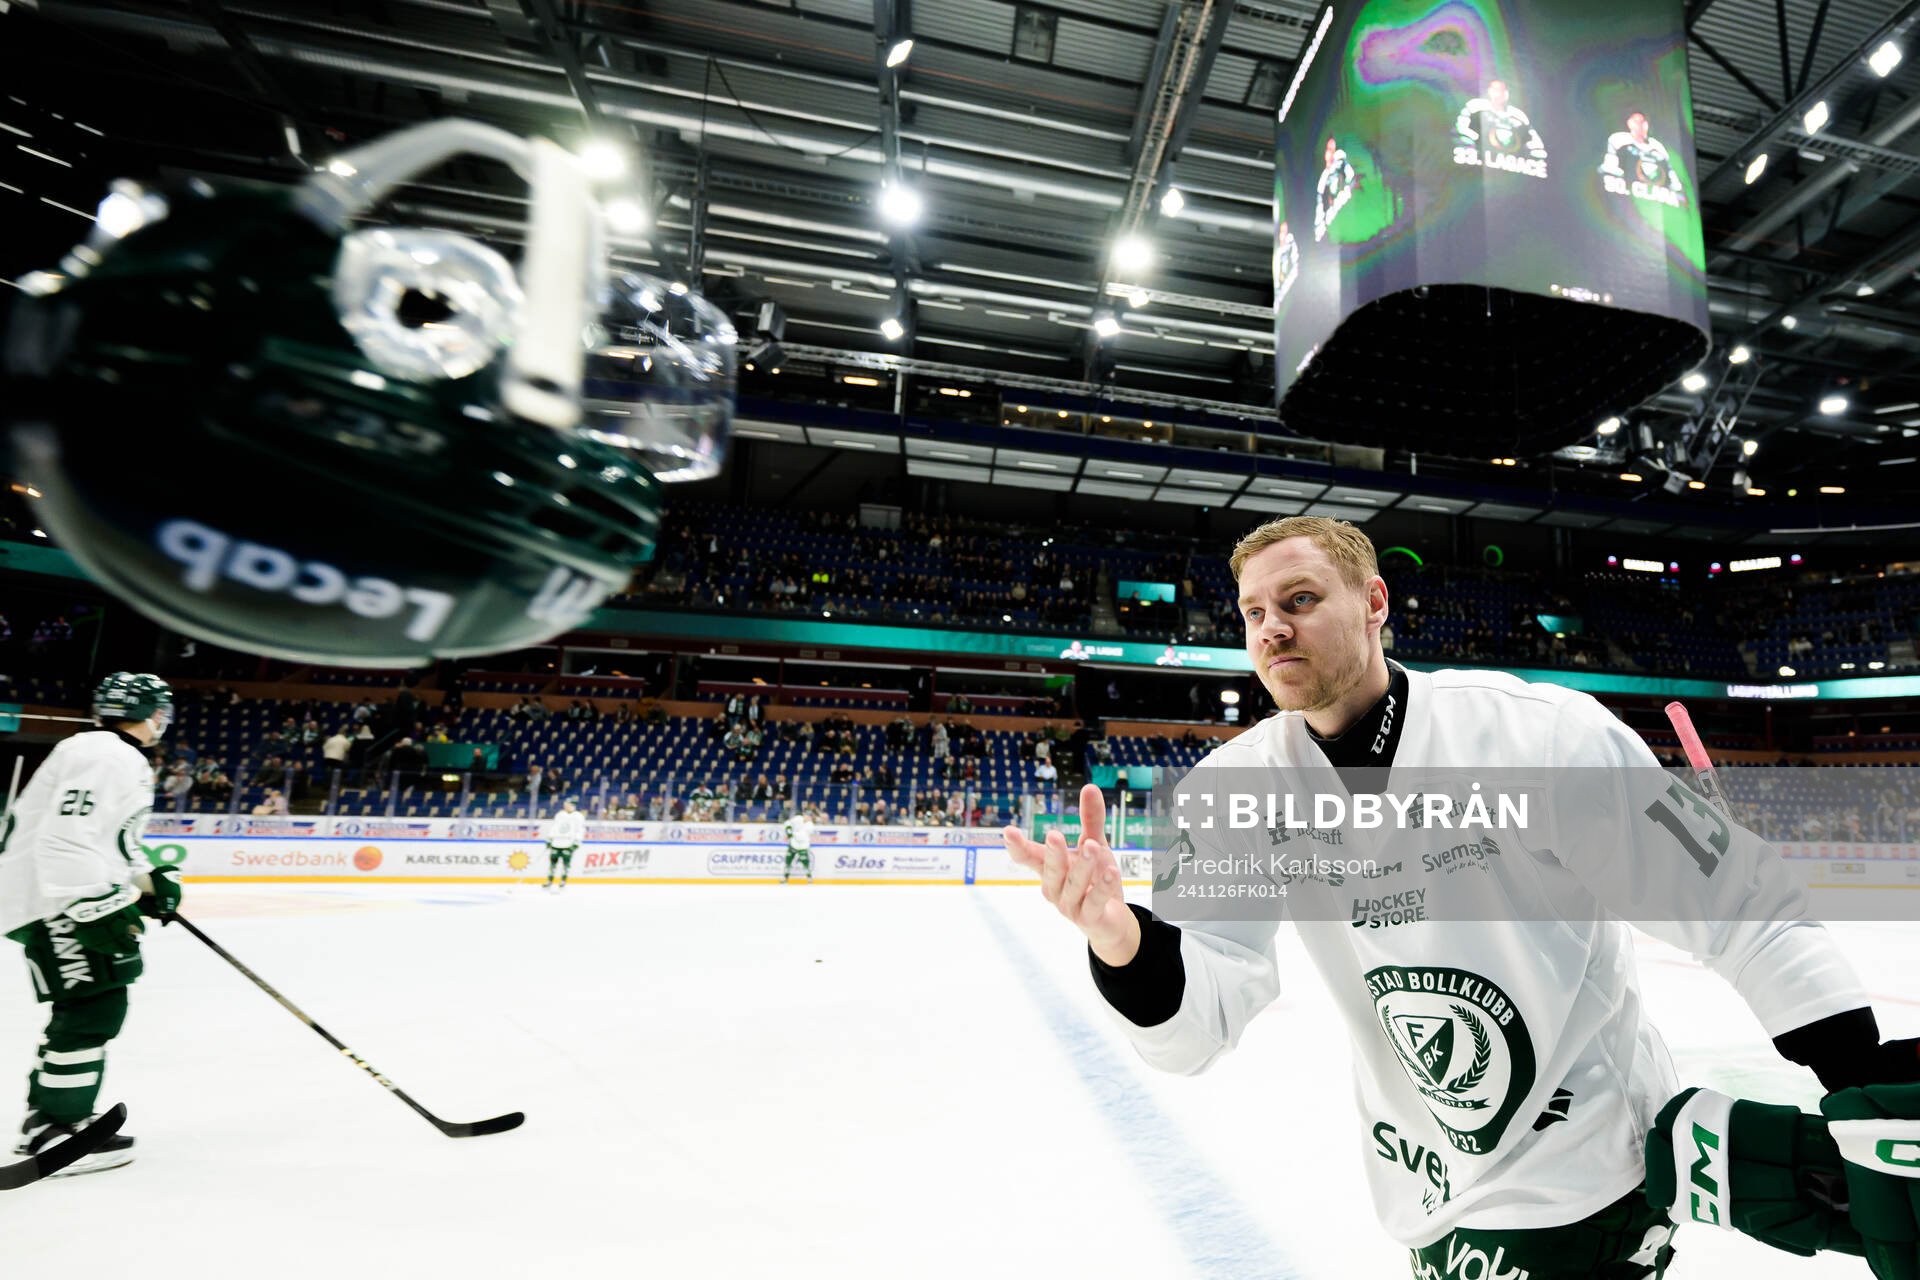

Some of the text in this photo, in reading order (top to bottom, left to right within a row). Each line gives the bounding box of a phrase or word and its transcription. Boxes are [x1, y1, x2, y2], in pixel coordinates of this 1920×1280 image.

[157, 519, 455, 642] Lecab
[1370, 694, 1397, 754] CCM
[59, 788, 95, 816] 26
[1644, 775, 1731, 879] 13
[231, 850, 347, 867] Swedbank
[405, 854, 500, 866] KARLSTAD.SE
[711, 853, 786, 865] GRUPPRESO
[834, 854, 886, 870] Salos
[1351, 887, 1427, 928] HOCKEY
[1366, 970, 1515, 1027] STAD BOLLKLUBB
[1423, 1038, 1445, 1070] BK
